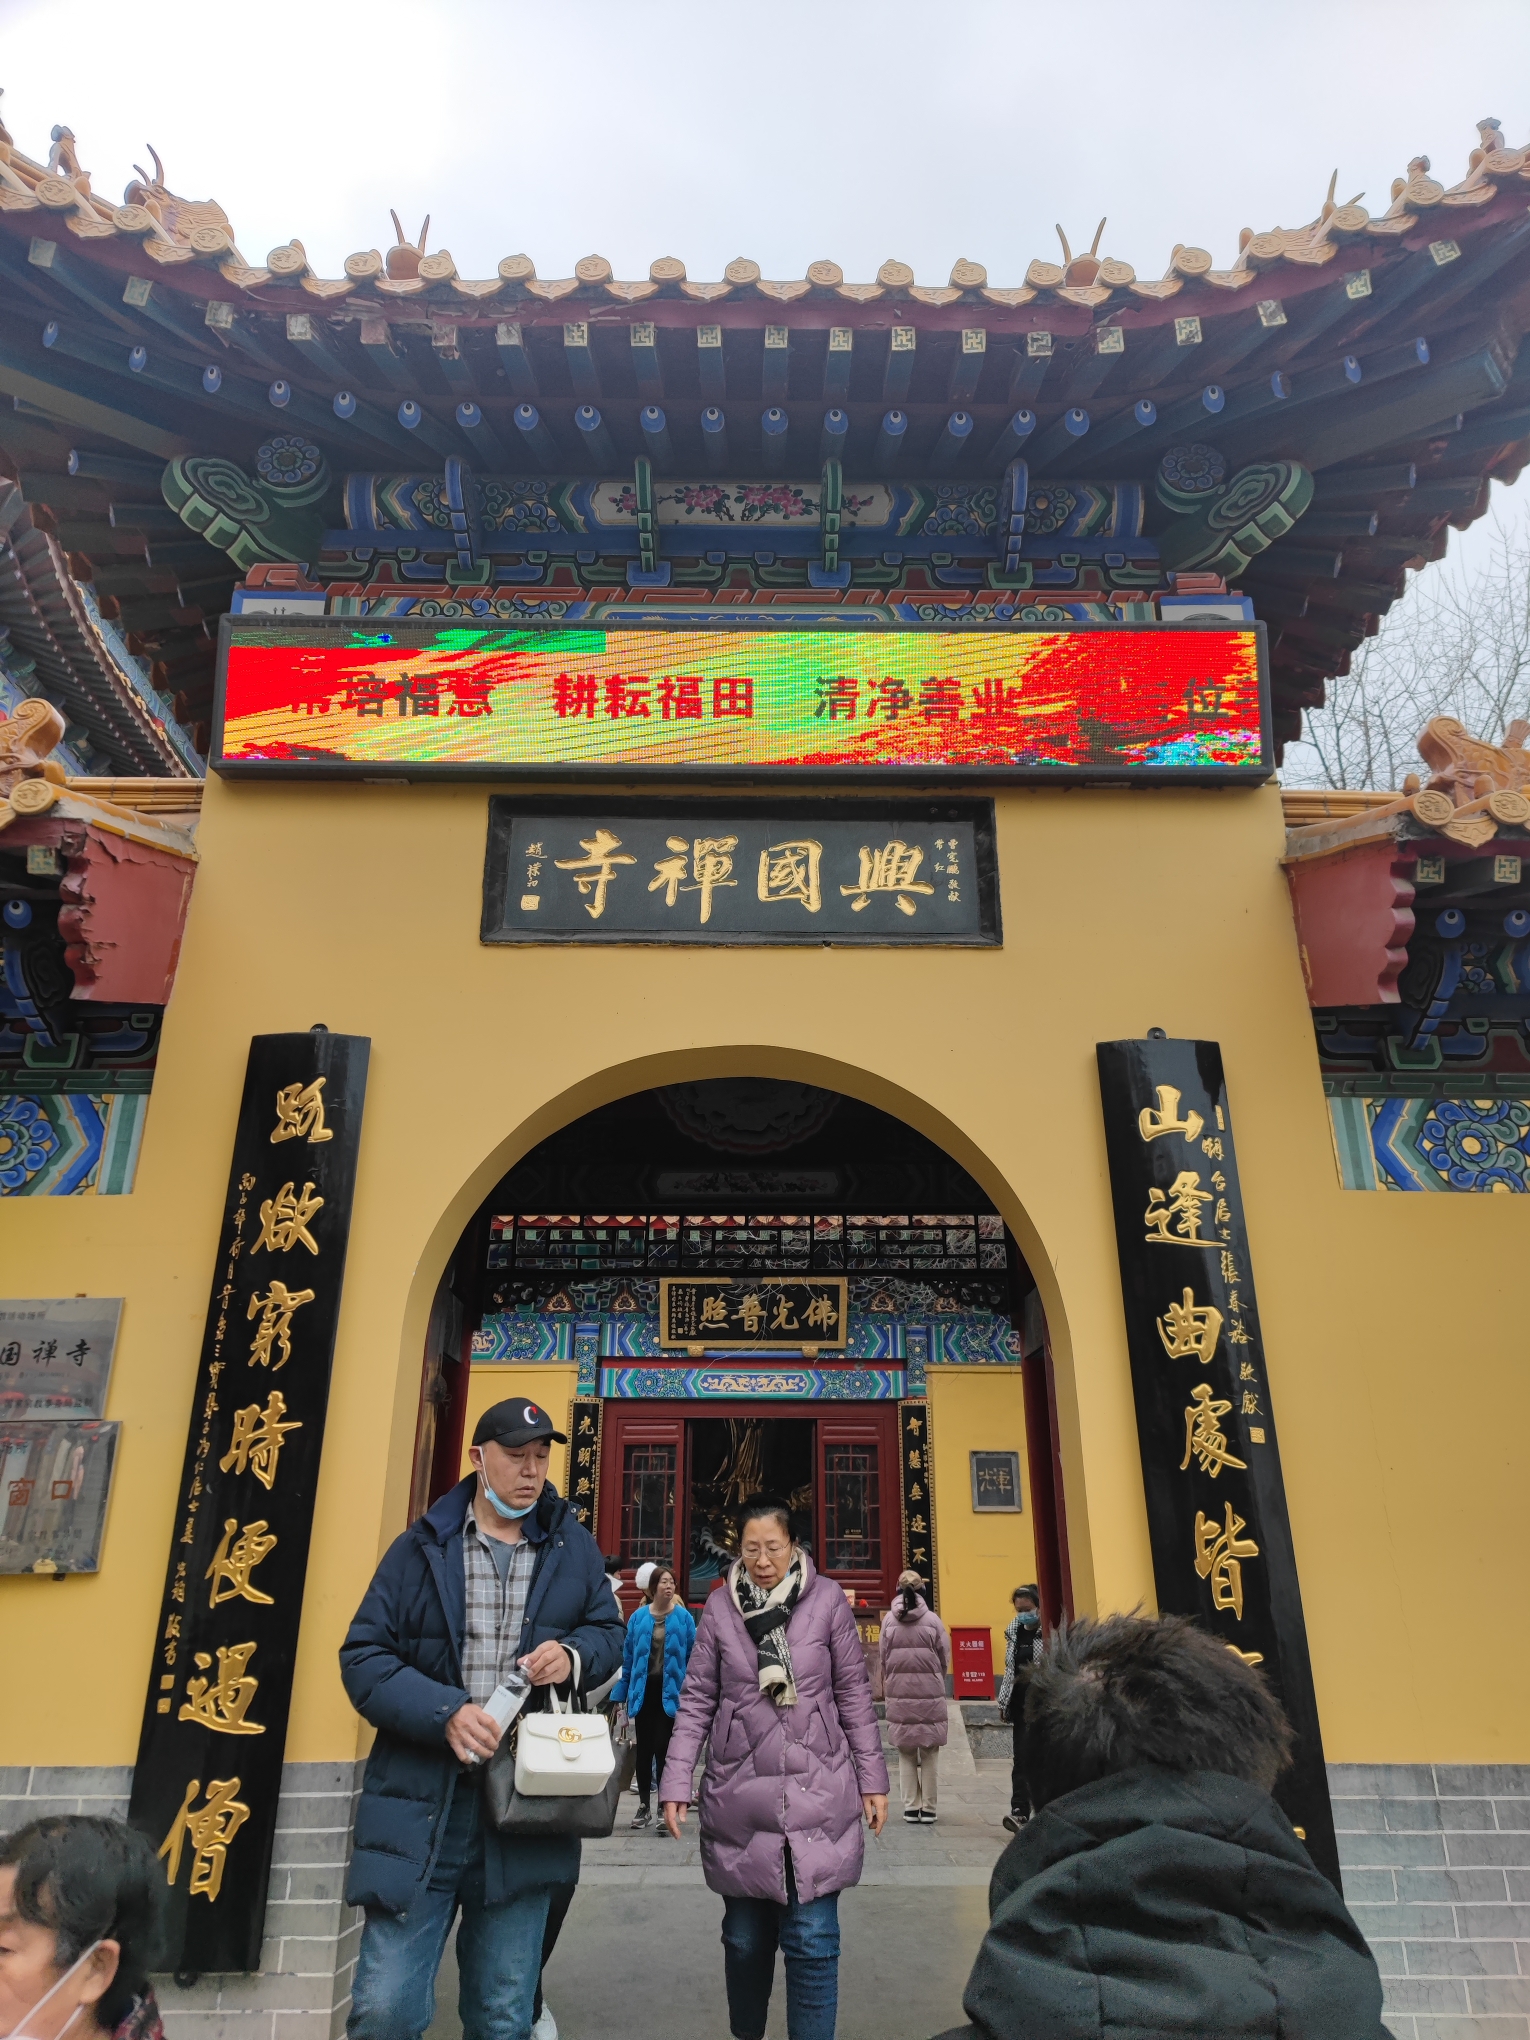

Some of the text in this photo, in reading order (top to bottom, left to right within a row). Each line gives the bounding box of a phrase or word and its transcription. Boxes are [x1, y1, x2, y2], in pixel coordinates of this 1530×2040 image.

[552, 675, 753, 719] 耕耘福田
[813, 677, 1018, 720] 清净善业
[699, 1293, 838, 1333] 佛光普照
[0, 1339, 91, 1367] 国禅寺
[1139, 1084, 1264, 1667] 山逢曲處皆
[8, 1478, 73, 1506] 窗口
[906, 1416, 930, 1583] 智慧無邊不
